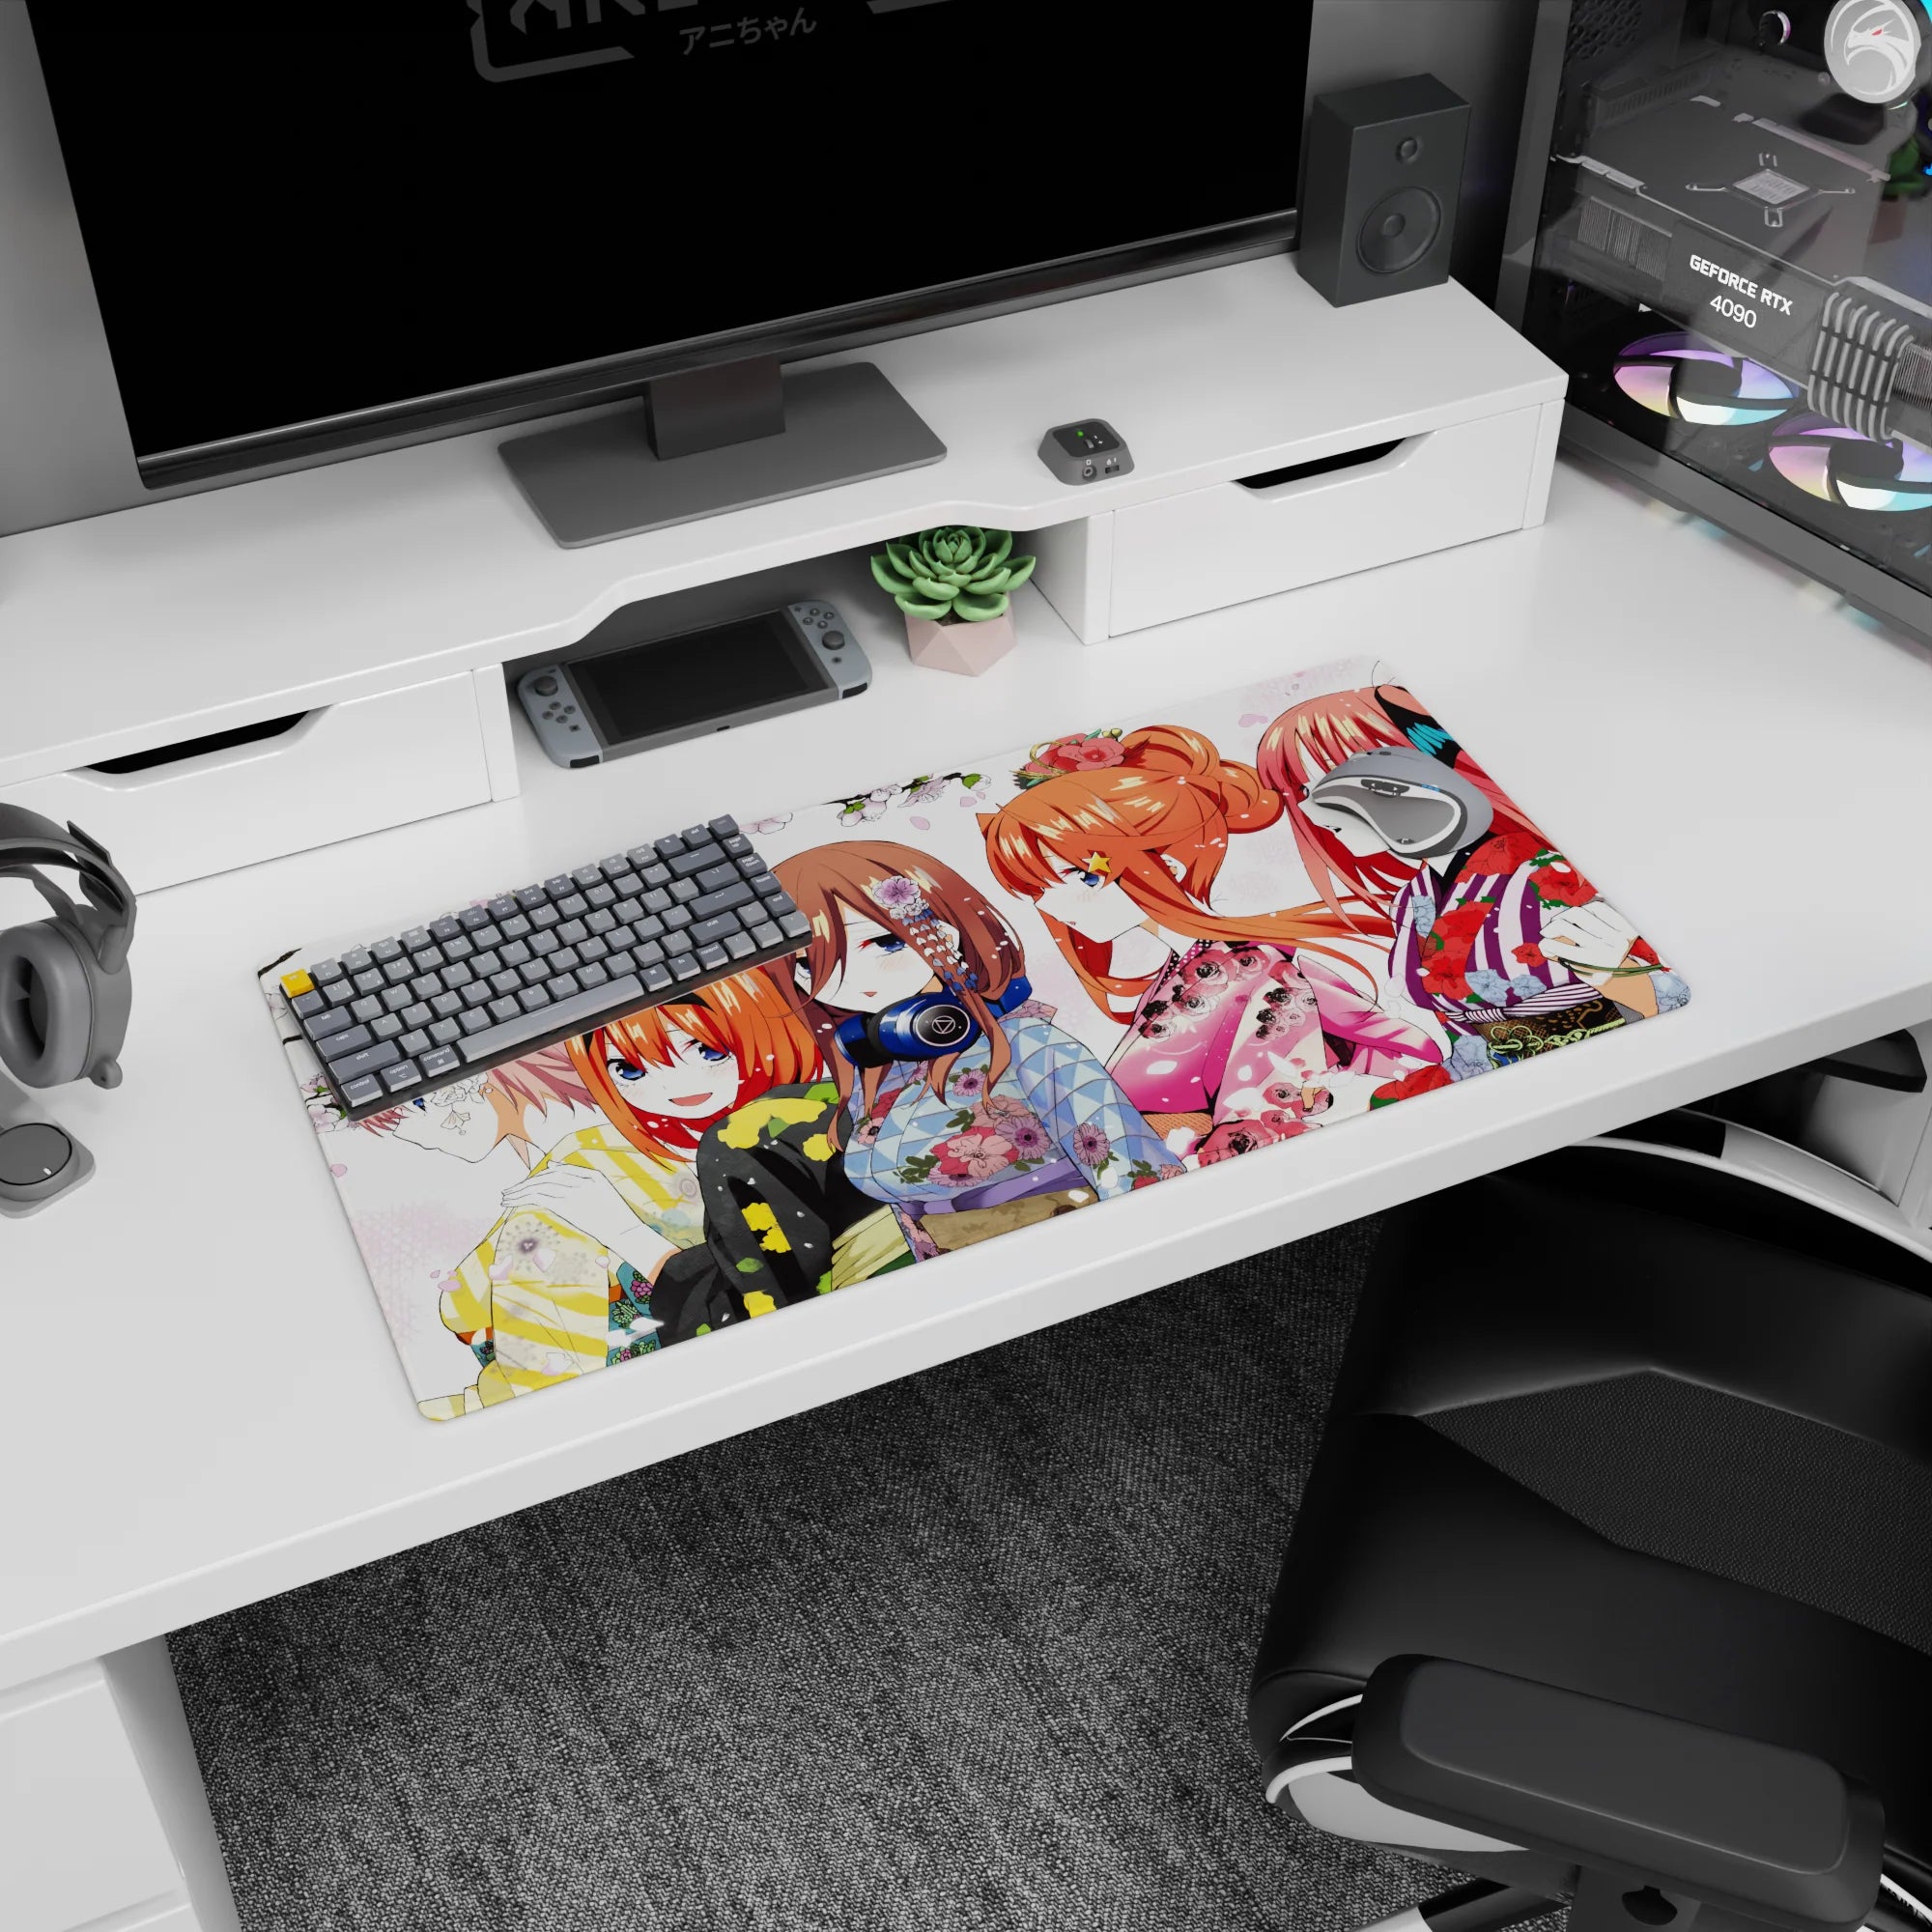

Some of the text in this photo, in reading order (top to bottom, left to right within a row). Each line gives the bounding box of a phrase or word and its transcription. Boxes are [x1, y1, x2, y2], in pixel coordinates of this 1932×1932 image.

[679, 6, 817, 55] アニちゃん
[1690, 254, 1794, 316] GEFORCE RTX
[1710, 295, 1757, 328] 4090
[701, 944, 719, 955] control
[423, 1047, 450, 1061] command
[389, 1065, 408, 1074] option
[350, 1078, 370, 1089] control
